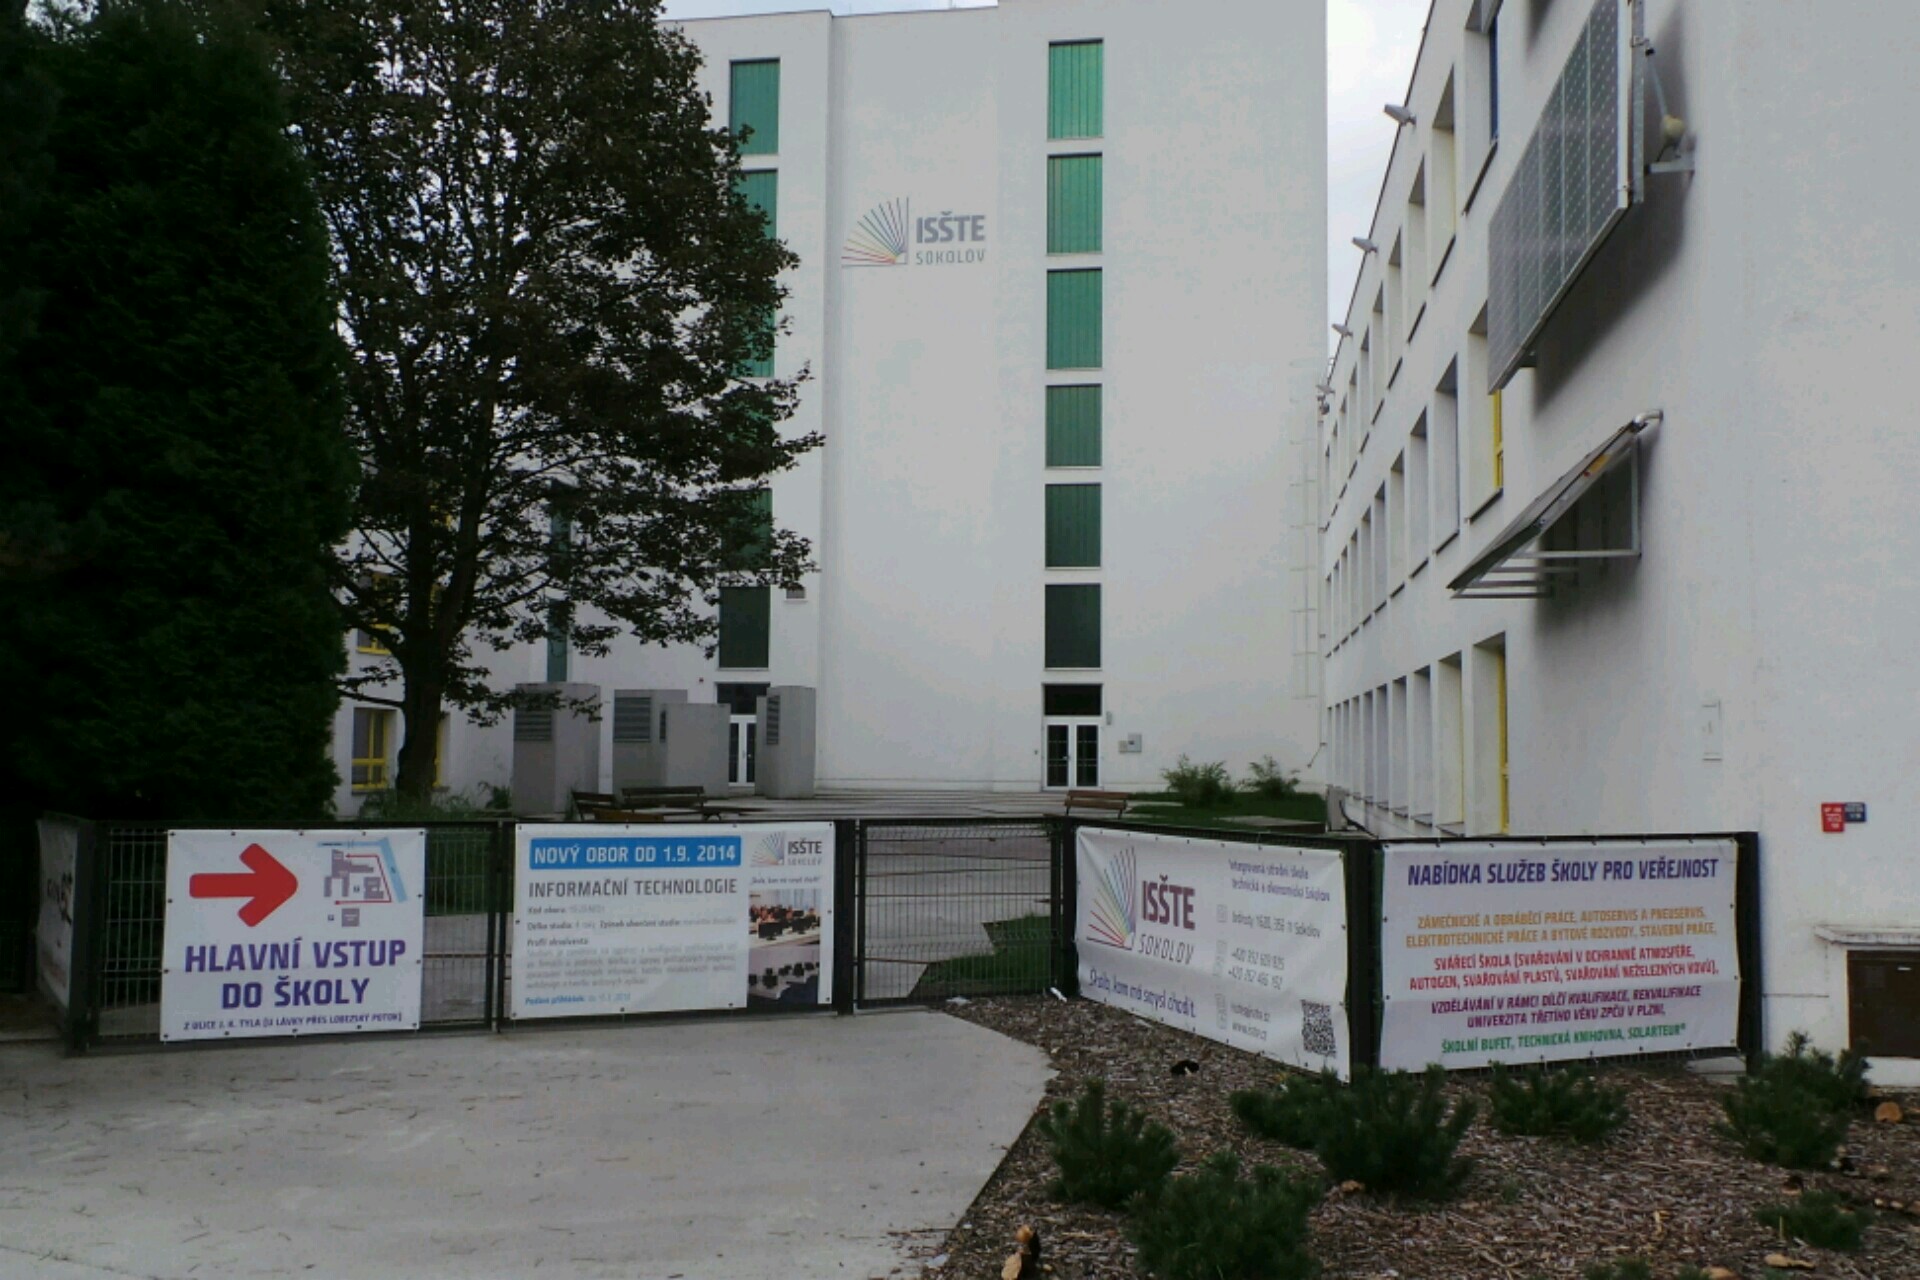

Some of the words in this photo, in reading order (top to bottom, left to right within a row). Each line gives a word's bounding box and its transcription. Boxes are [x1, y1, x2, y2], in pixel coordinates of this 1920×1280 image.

[916, 211, 985, 244] ISŠTE
[915, 249, 986, 265] SOKOLOV
[534, 844, 580, 864] NOVÝ
[586, 846, 628, 862] OBOR
[635, 846, 656, 862] OD
[664, 845, 690, 862] 1.9.
[697, 845, 736, 861] 2014
[788, 837, 822, 854] ISŠTE
[1408, 861, 1481, 885] NABÍDKA
[1487, 859, 1546, 883] SLUŽEB
[1551, 859, 1597, 881] ŠKOLY
[1603, 861, 1633, 880] PRO
[1639, 856, 1719, 880] VEŘEJNOST
[529, 877, 628, 897] INFORMAČNÍ
[634, 878, 737, 895] TECHNOLOGIE
[1142, 873, 1196, 930] ISŠTE
[1418, 913, 1480, 929] ZÁMEČNICKÉ
[1483, 914, 1490, 926] A
[1493, 911, 1541, 925] OBRÁBĚCÍ
[1580, 909, 1638, 922] AUTOSERVIS
[1641, 908, 1648, 920] A
[1406, 930, 1504, 948] ELEKTROTECHNICKÉ
[1507, 929, 1538, 943] PRÁCE
[1541, 929, 1548, 941] A
[1551, 926, 1588, 940] BYTOVÉ
[1640, 922, 1683, 937] STAVEBNÍ
[1686, 921, 1717, 935] PRÁCE,
[185, 937, 302, 972] HLAVNÍ
[312, 940, 406, 968] VSTUP
[1138, 933, 1194, 965] SOKOLOV
[1434, 953, 1476, 970] SVÁŘECÍ
[1479, 952, 1511, 968] ŠKOLA
[1576, 950, 1583, 962] V
[1586, 946, 1636, 962] OCHRANNÉ
[1410, 974, 1460, 990] AUTOGEN,
[1463, 970, 1520, 986] SVAŘOVÁNÍ
[1523, 966, 1563, 984] PLASTŮ,
[1565, 964, 1620, 981] SVAŘOVÁNÍ
[1623, 961, 1685, 978] NEŽELEZNÝCH
[222, 982, 262, 1009] DO
[274, 976, 370, 1006] ŠKOLY
[1431, 996, 1494, 1014] VZDĚLÁVÁNÍ
[1497, 998, 1504, 1010] V
[1507, 994, 1539, 1008] RÁMCI
[1542, 990, 1567, 1006] DÍLČÍ
[1568, 990, 1629, 1004] KVALIFIKACE,
[1633, 985, 1701, 1000] REKVALIFIKACE
[191, 1020, 216, 1030] ULICE
[240, 1018, 261, 1028] TYLA
[276, 1016, 303, 1026] LÁVKY
[1467, 1013, 1527, 1028] UNIVERZITA
[1531, 1009, 1571, 1023] TŘETÍHO
[1574, 1006, 1598, 1020] VĚKU
[1627, 1005, 1634, 1016] V
[1441, 1037, 1478, 1053] ŠKOLNÍ
[1481, 1037, 1514, 1051] BUFET,
[1518, 1030, 1571, 1047] TECHNICKÁ
[1574, 1027, 1624, 1043] KNIHOVNA,
